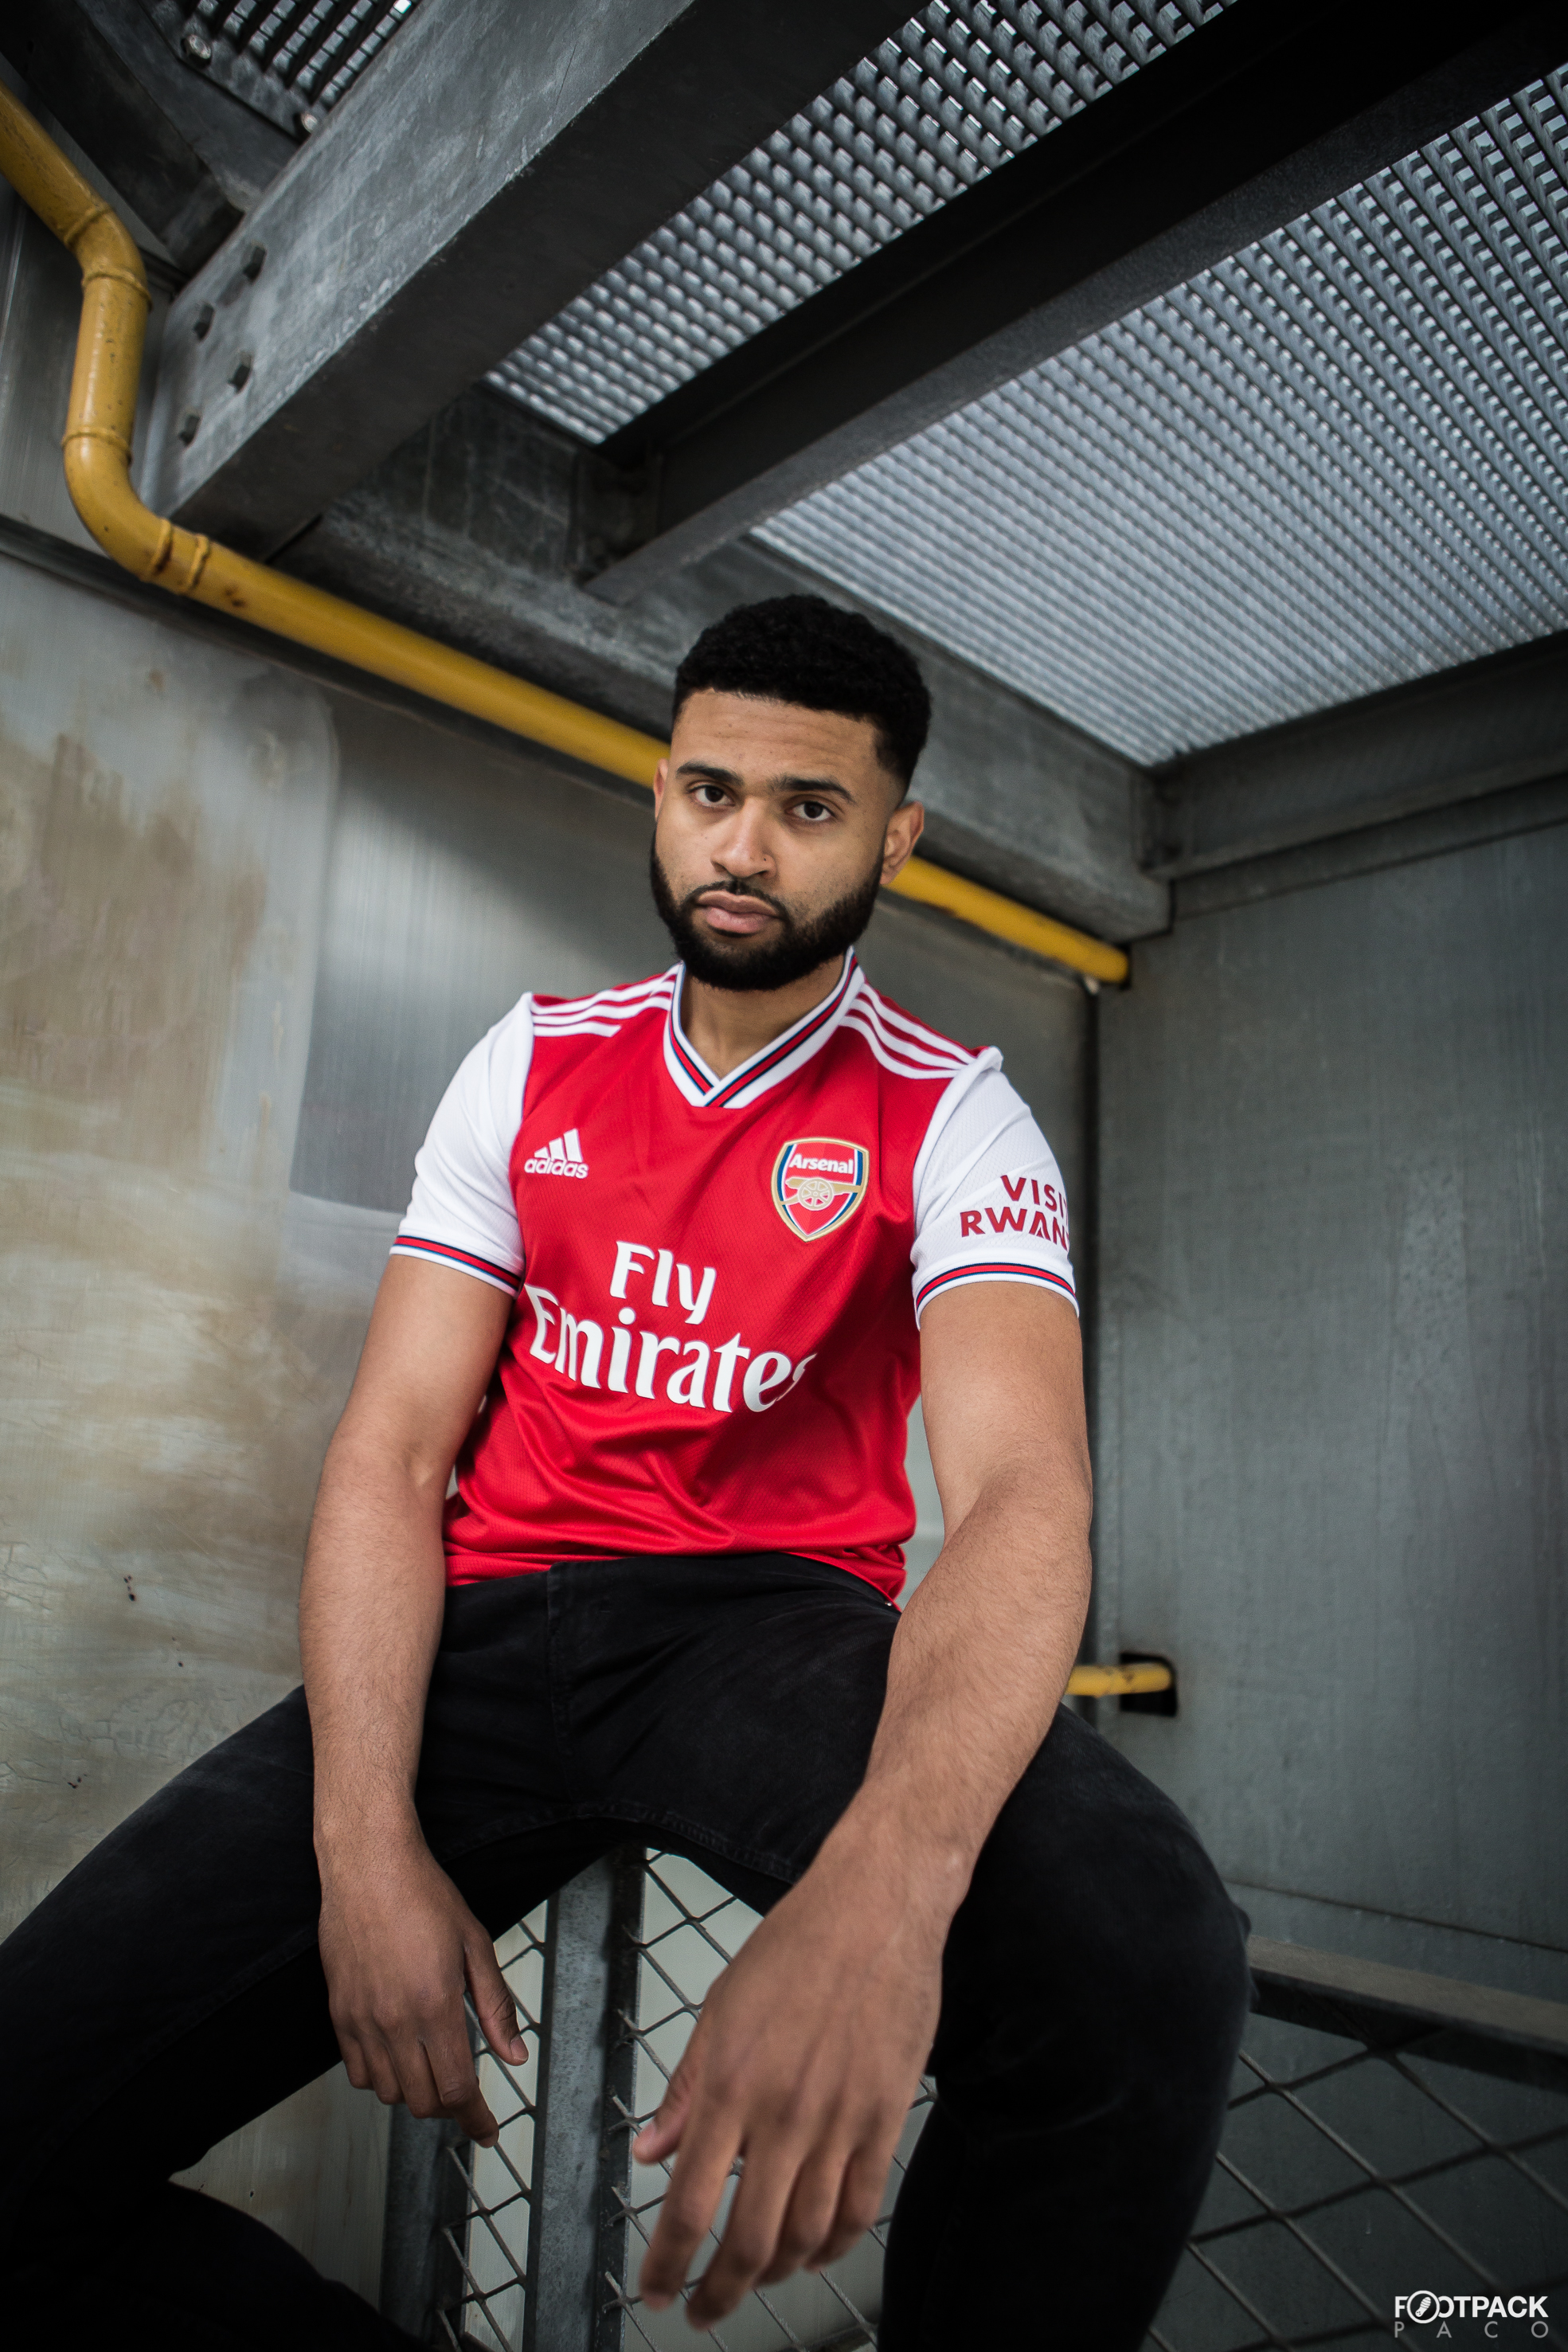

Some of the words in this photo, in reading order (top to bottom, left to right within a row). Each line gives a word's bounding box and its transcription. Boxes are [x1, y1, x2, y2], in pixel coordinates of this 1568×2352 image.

[524, 1157, 588, 1179] adidas
[789, 1154, 854, 1174] Arsenal
[960, 1207, 1069, 1253] RWAN
[609, 1240, 717, 1325] Fly
